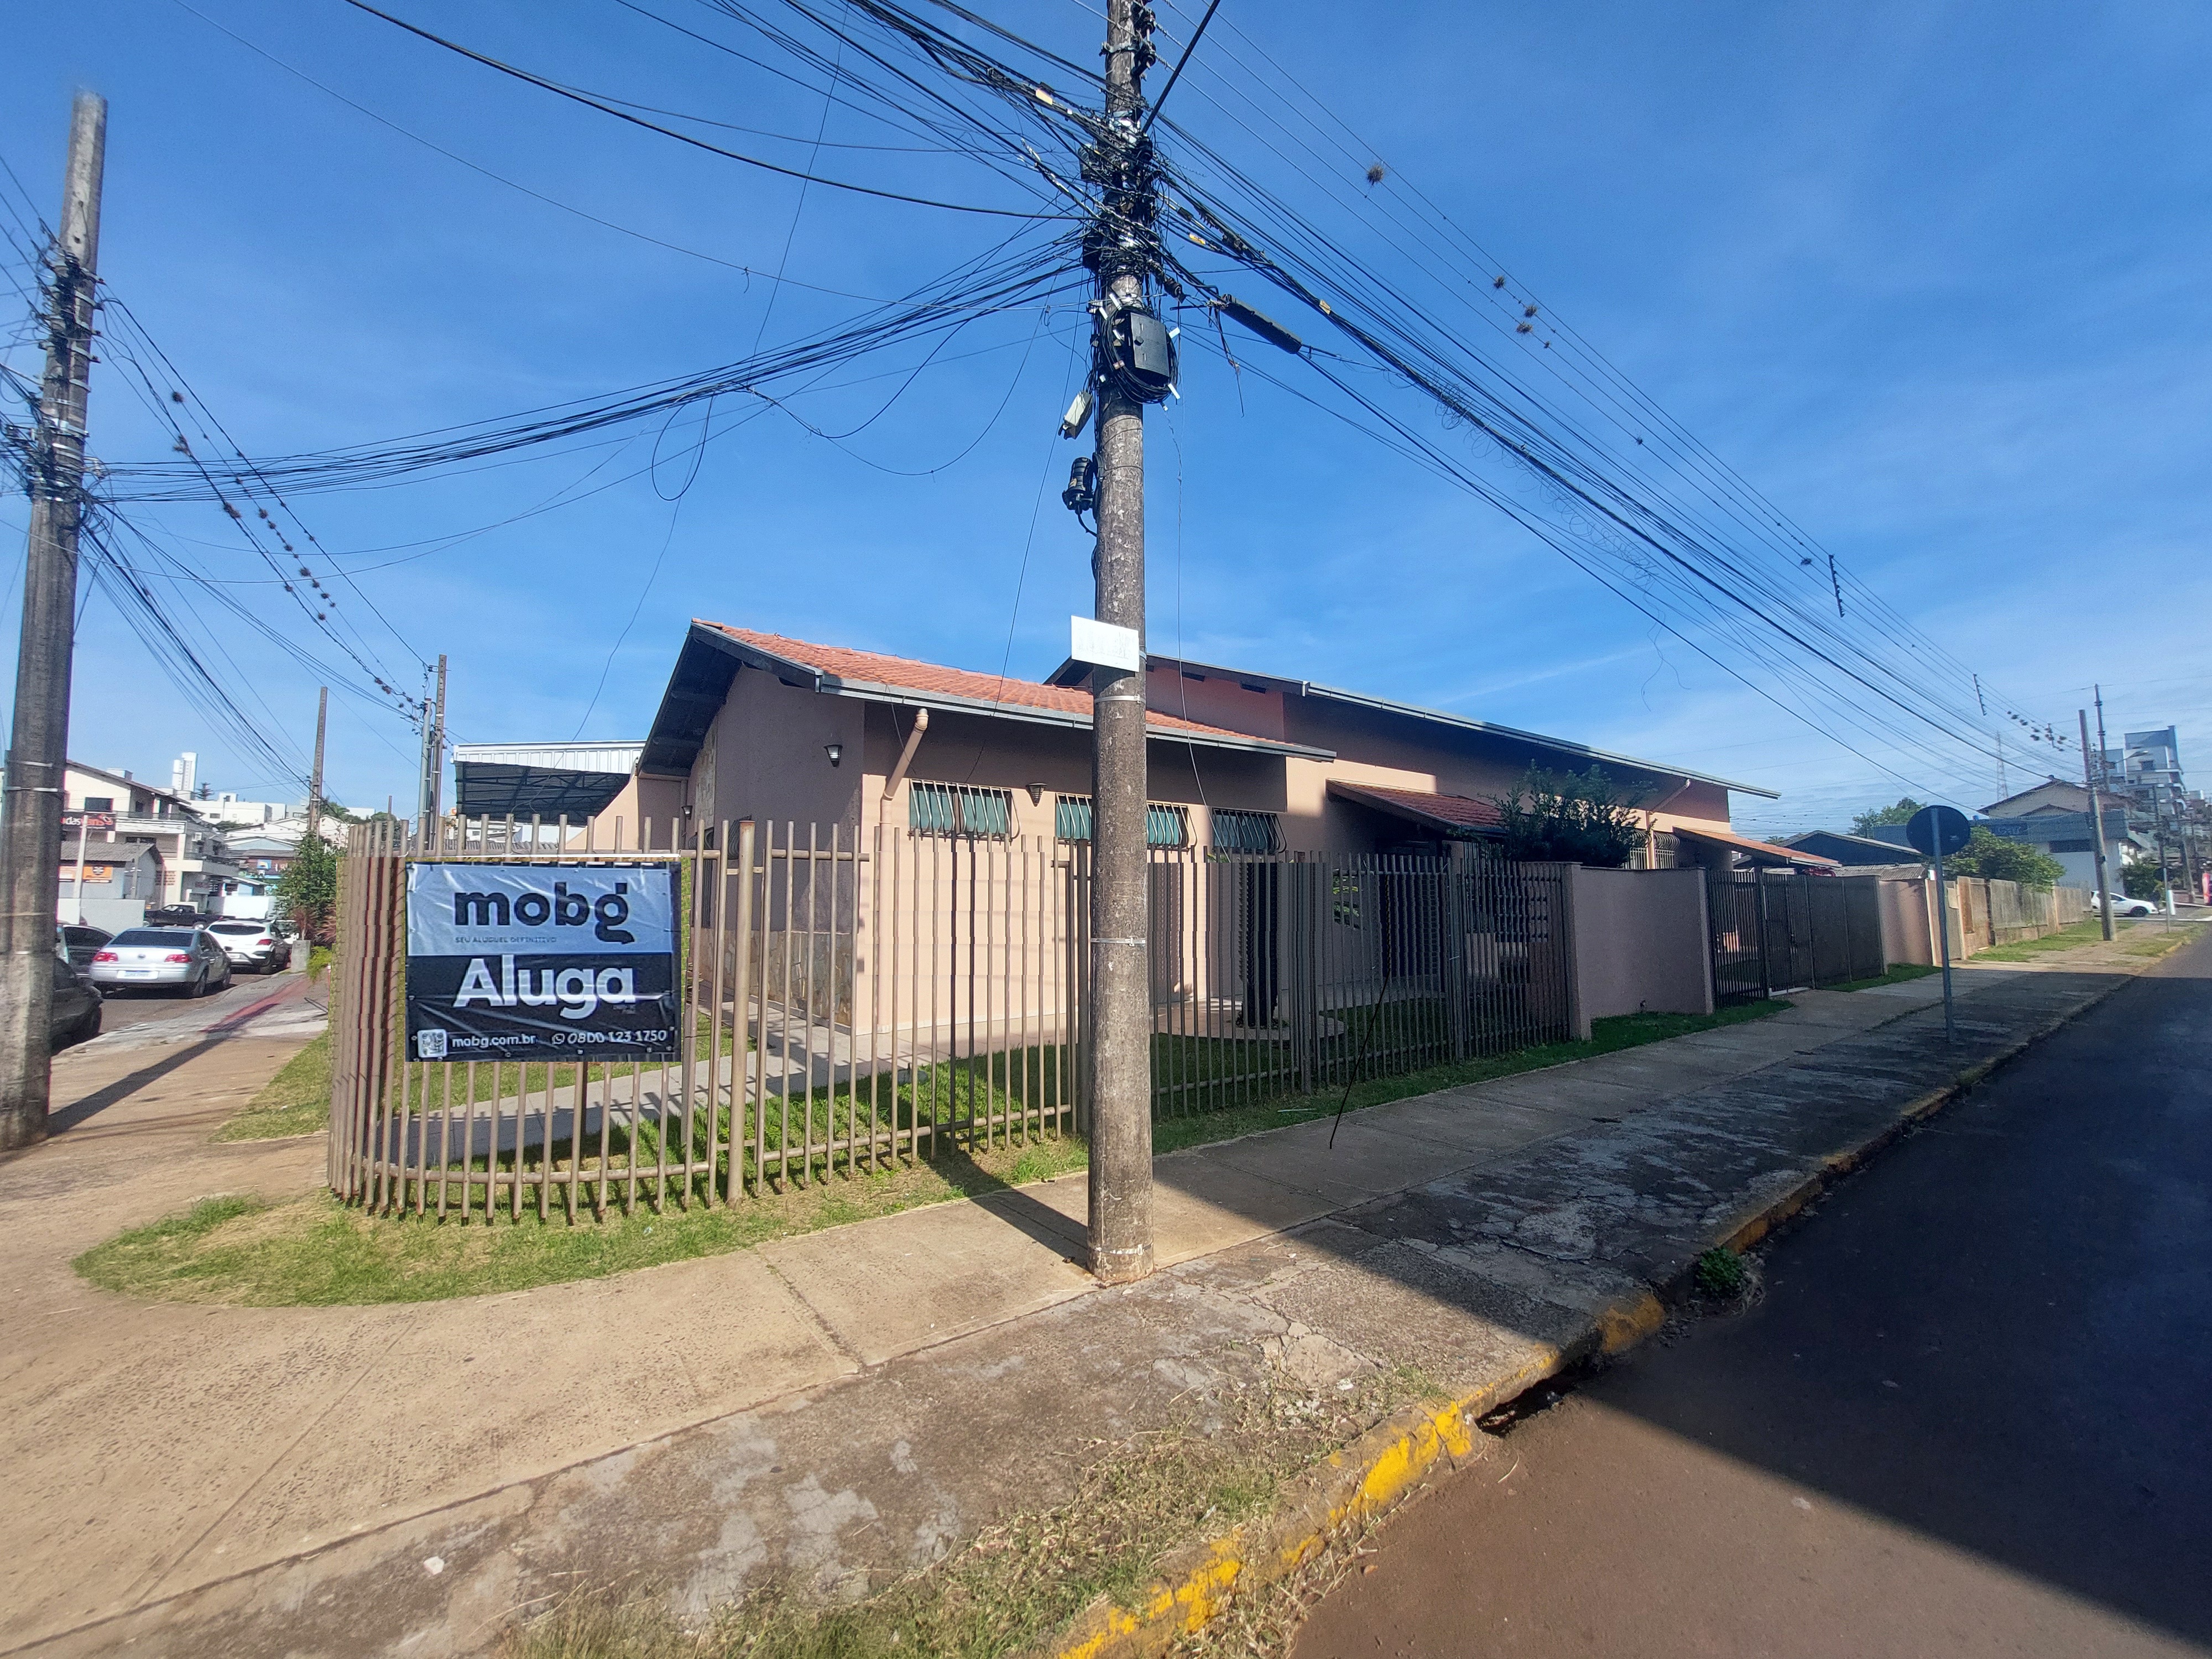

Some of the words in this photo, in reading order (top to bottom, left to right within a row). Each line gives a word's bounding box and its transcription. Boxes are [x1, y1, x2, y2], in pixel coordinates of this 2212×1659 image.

[455, 882, 635, 944] mobg
[453, 954, 636, 1019] Aluga
[452, 1033, 536, 1048] mobg.com.br
[608, 1031, 632, 1042] 123
[635, 1030, 667, 1041] 1750
